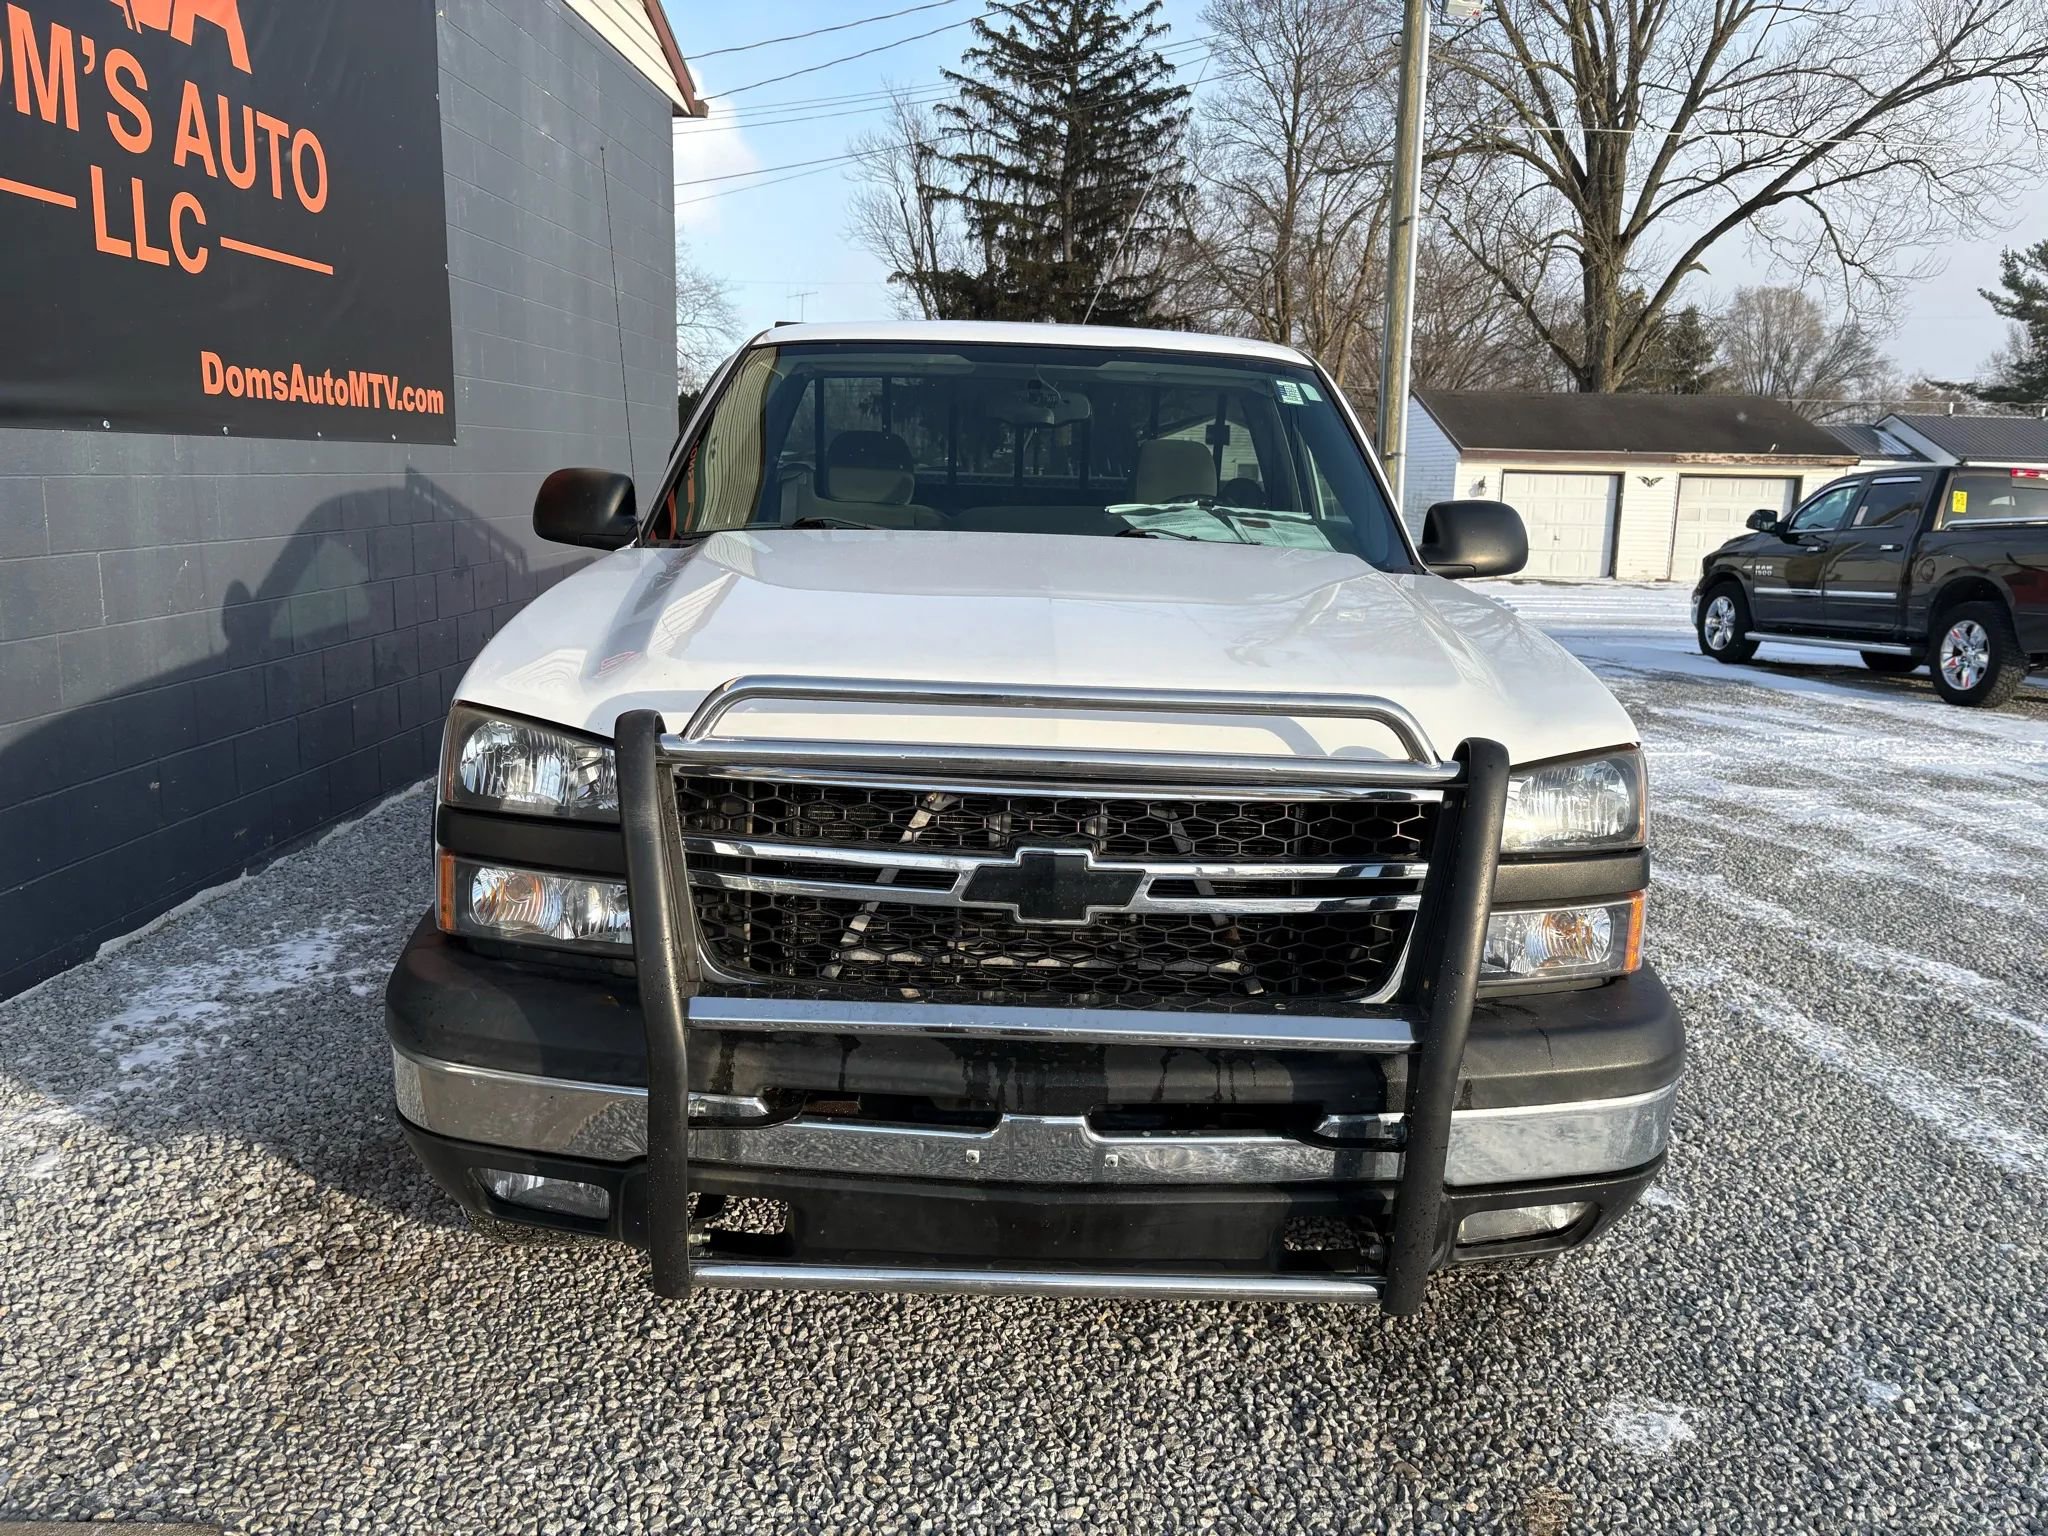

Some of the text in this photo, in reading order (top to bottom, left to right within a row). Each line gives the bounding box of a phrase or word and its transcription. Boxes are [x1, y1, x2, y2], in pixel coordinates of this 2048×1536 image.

[0, 3, 328, 213] M'S AUTO
[90, 165, 208, 274] LLC
[201, 351, 444, 414] DomsAutoMTV.com
